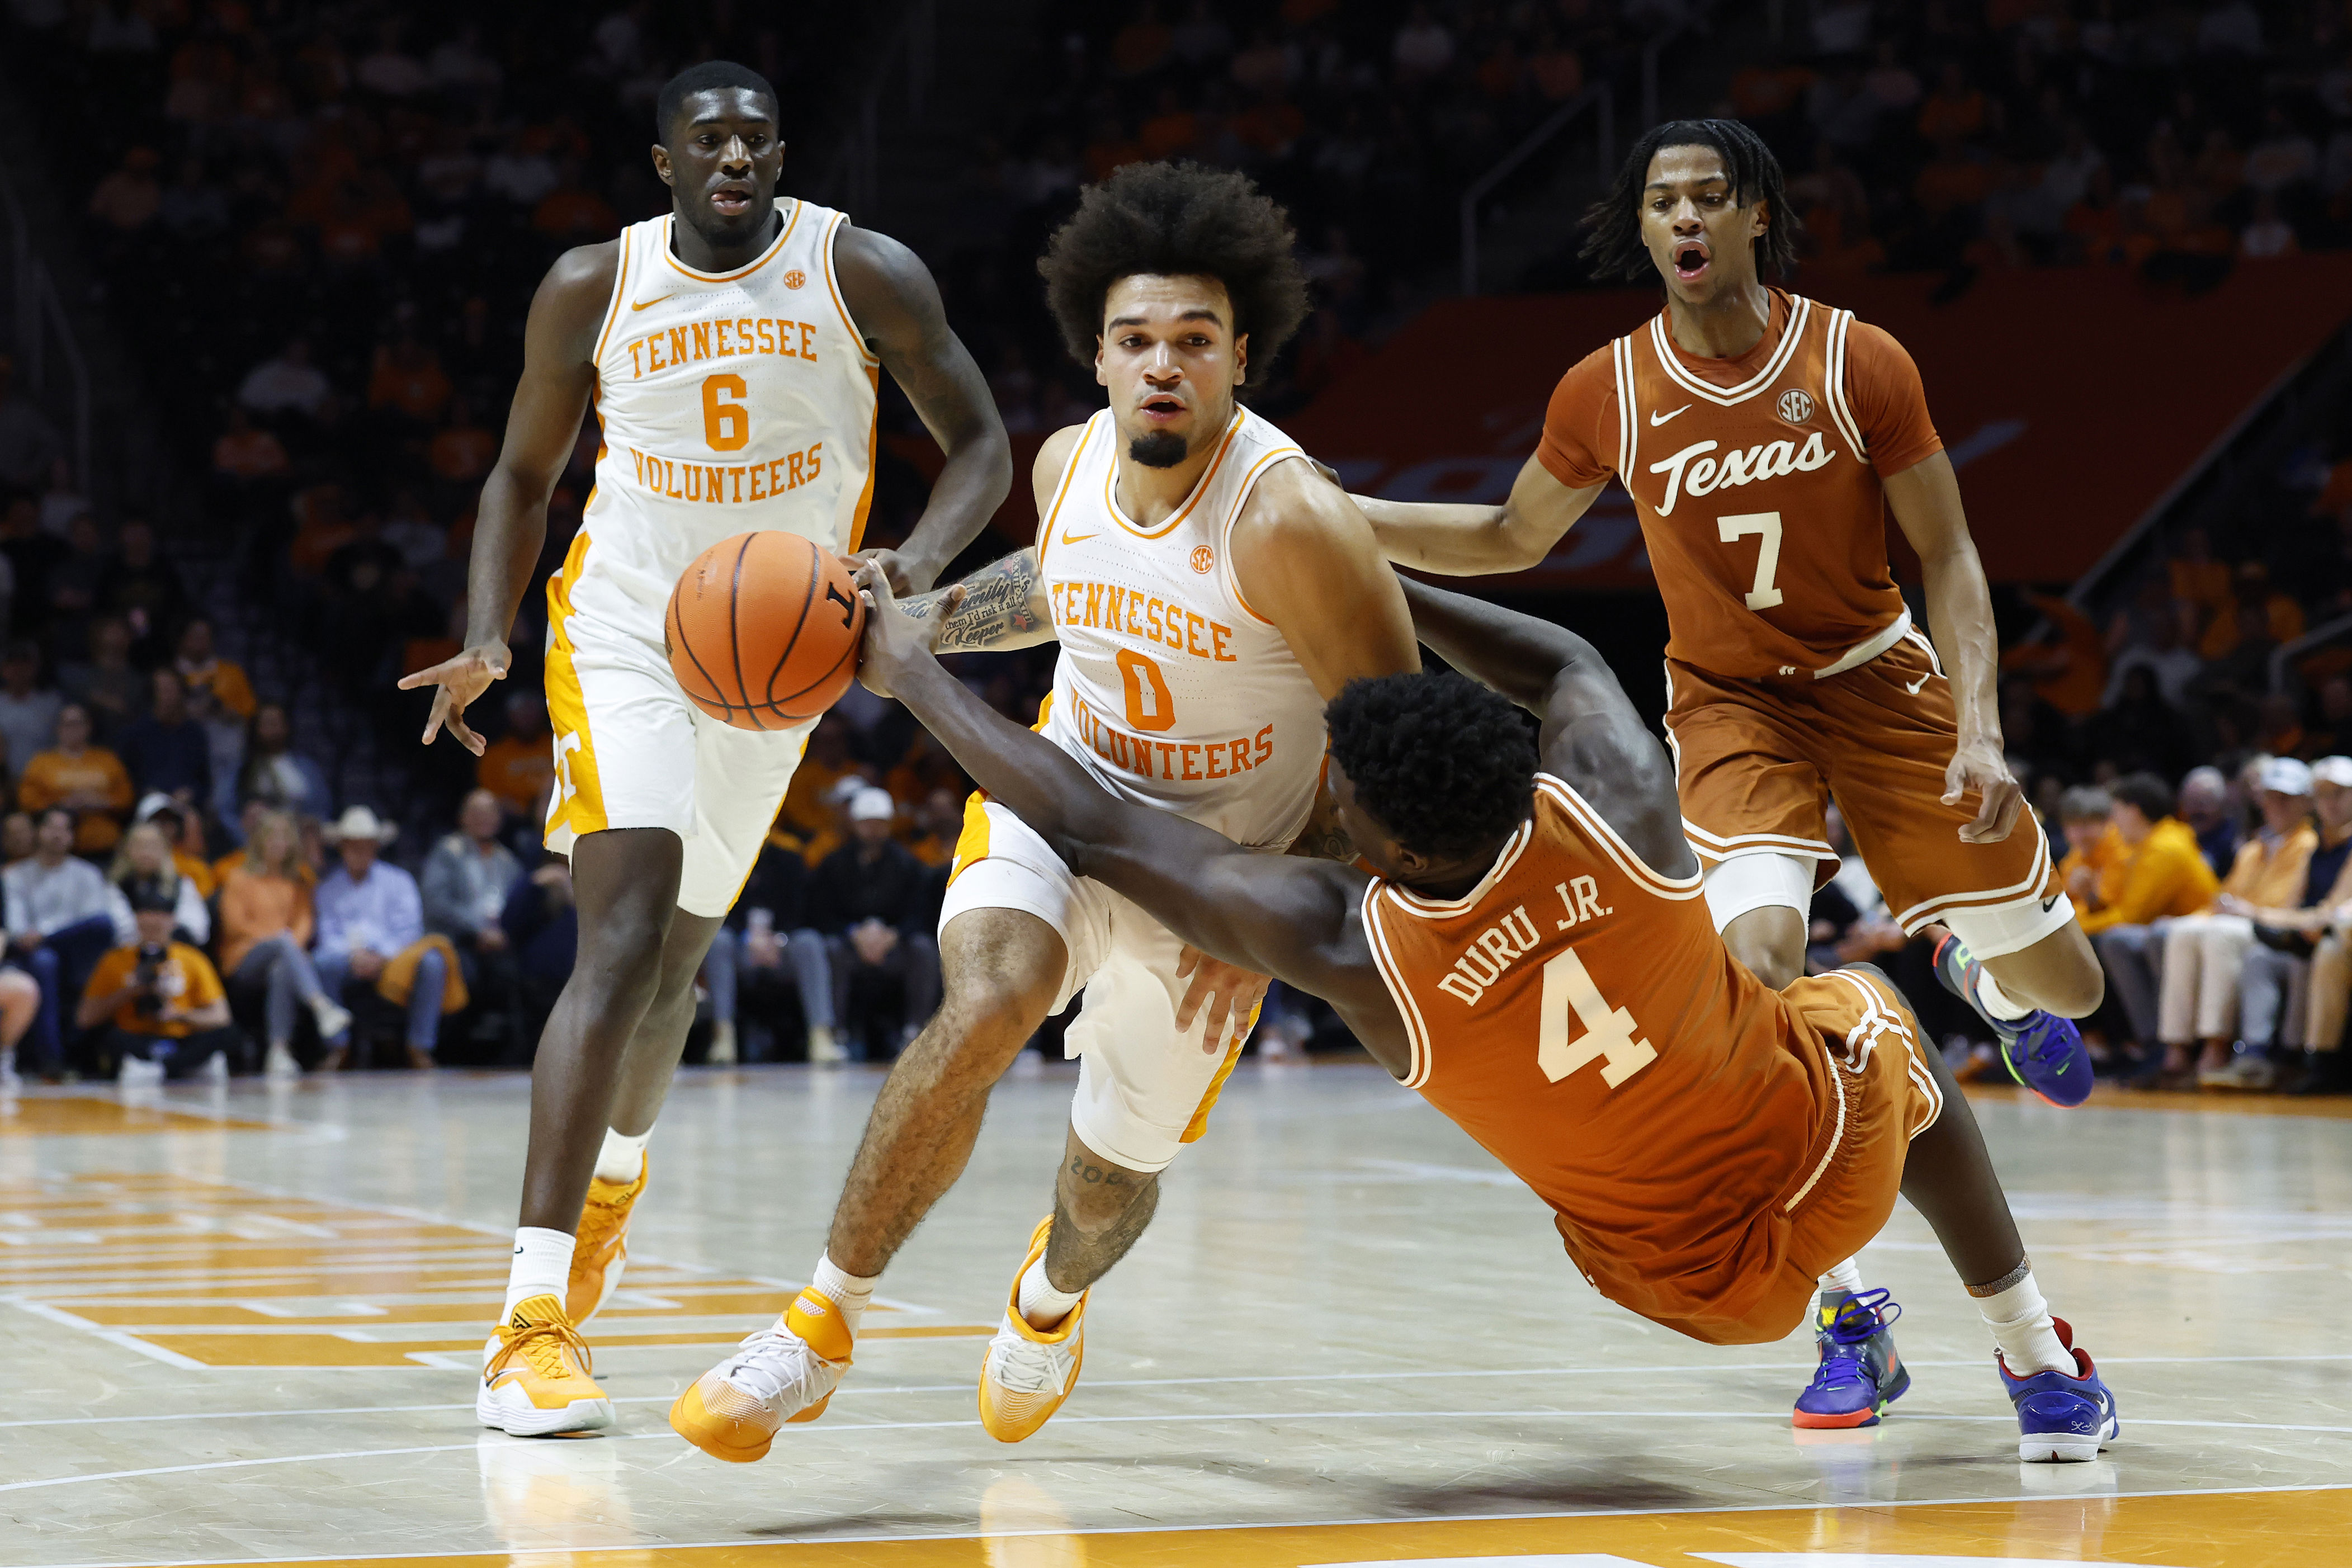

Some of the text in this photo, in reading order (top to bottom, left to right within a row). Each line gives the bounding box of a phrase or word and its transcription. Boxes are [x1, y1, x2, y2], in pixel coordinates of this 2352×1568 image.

[784, 270, 806, 290] SEC
[628, 318, 818, 380] TENNESSEE
[701, 374, 749, 452] 6
[1778, 390, 1813, 423] SEC
[629, 441, 823, 504] VOLUNTEERS
[1650, 431, 1836, 517] Texas
[1191, 545, 1214, 574] SEC
[1716, 511, 1784, 611] 7
[944, 621, 1005, 646] Keeper
[1051, 582, 1237, 662] TENNESSEE
[1115, 648, 1177, 731] 0
[1070, 683, 1273, 781] VOLUNTEERS
[1437, 874, 1614, 1007] DURU JR.
[1537, 946, 1659, 1090] 4
